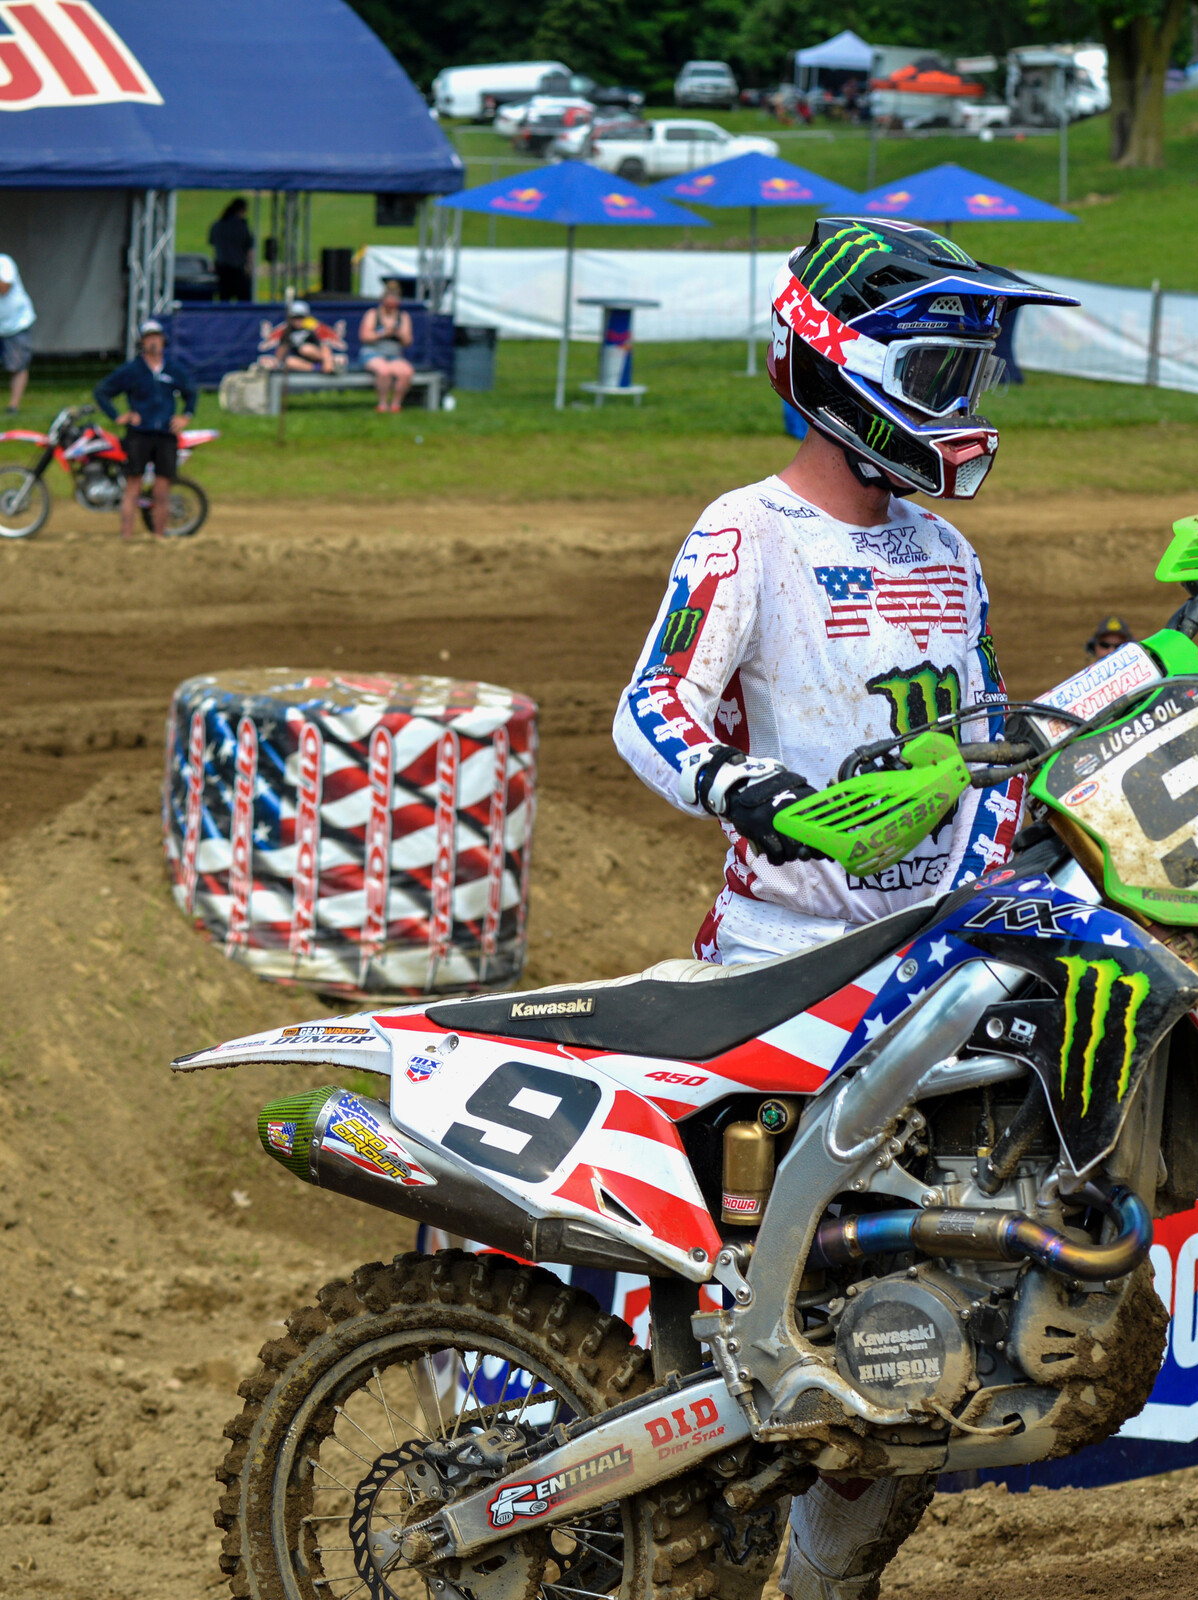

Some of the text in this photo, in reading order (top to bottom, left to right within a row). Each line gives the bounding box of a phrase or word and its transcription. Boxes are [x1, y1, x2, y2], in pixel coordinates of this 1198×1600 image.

[1042, 649, 1139, 709] ENTHAL
[1100, 699, 1182, 760] LUCAS OIL
[963, 896, 1101, 935] KX
[511, 998, 593, 1018] Kawasaki
[269, 1035, 377, 1046] DUNLOP
[644, 1071, 710, 1087] 450
[345, 1118, 388, 1152] PRO
[441, 1061, 602, 1183] 9
[332, 1124, 408, 1180] CIRCUIT
[852, 1323, 936, 1348] Kawasaki
[864, 1341, 928, 1356] Racing Team
[858, 1357, 940, 1381] HINSON
